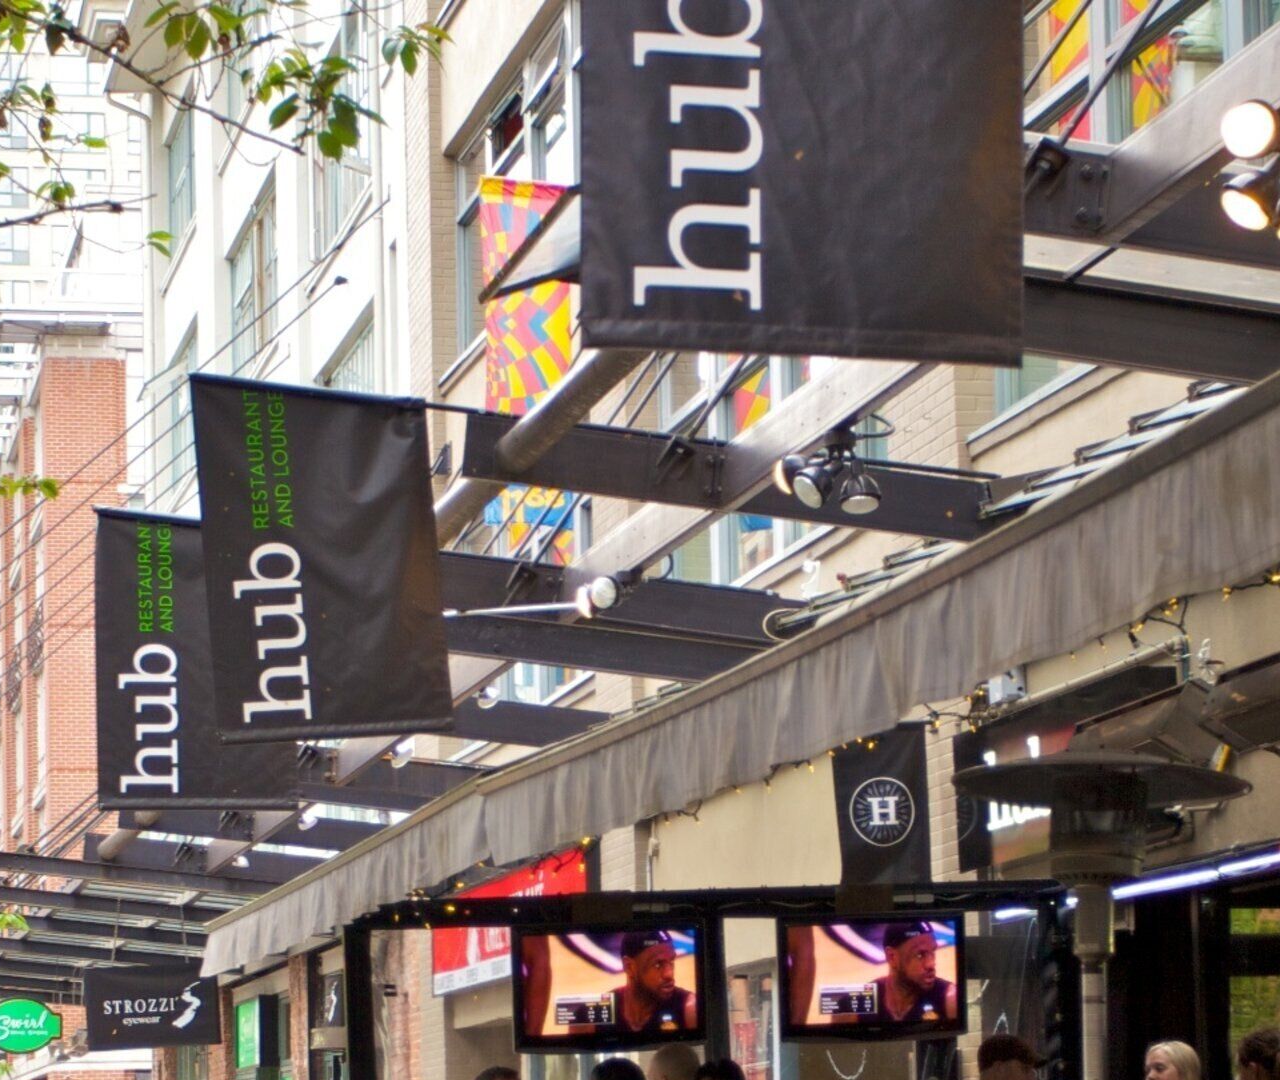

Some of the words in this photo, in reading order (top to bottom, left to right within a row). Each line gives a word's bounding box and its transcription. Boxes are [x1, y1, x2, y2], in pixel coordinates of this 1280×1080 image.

[633, 0, 763, 311] hub
[242, 391, 269, 530] RESTAURANT
[268, 391, 291, 479] LOUNGE
[276, 483, 295, 529] AND
[158, 595, 174, 633] AND
[233, 542, 313, 723] hub
[118, 643, 179, 794] hub
[868, 796, 899, 826] H
[122, 1016, 162, 1026] eyewear
